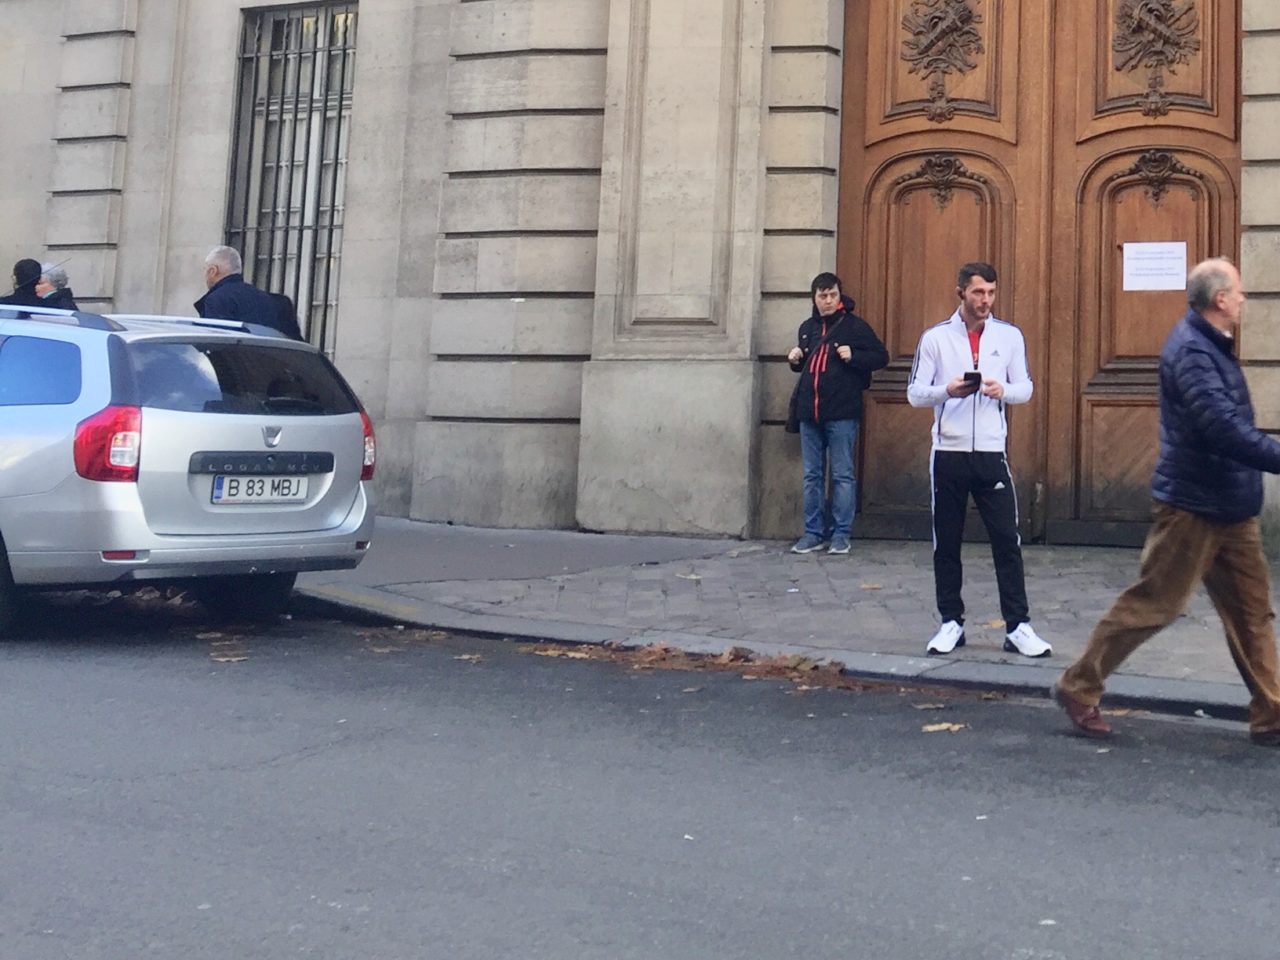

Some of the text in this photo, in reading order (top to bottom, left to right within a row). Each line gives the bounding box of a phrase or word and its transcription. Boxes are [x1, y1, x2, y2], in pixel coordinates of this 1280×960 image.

[228, 479, 301, 497] B 83 MBJ
